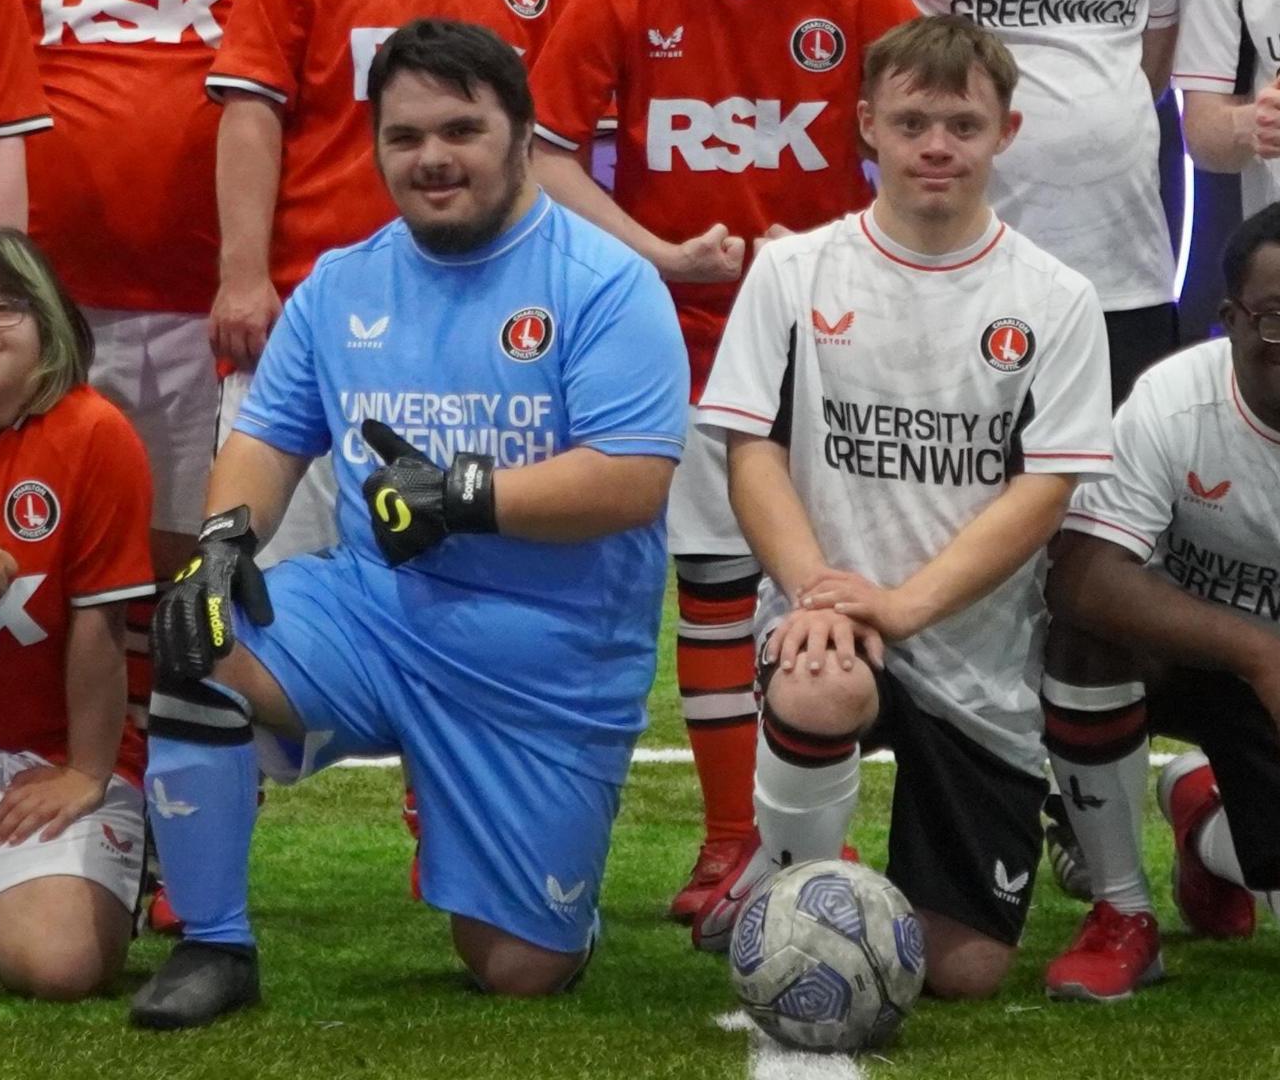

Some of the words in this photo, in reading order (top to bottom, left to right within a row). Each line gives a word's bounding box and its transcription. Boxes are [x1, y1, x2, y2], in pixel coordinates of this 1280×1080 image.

[646, 96, 830, 174] RSK
[816, 338, 852, 346] ASTORE
[992, 318, 1030, 334] CHARLTON
[340, 392, 502, 426] UNIVERSITY
[508, 394, 553, 428] OF
[343, 426, 554, 469] GENWICH
[207, 593, 224, 647] Sondico
